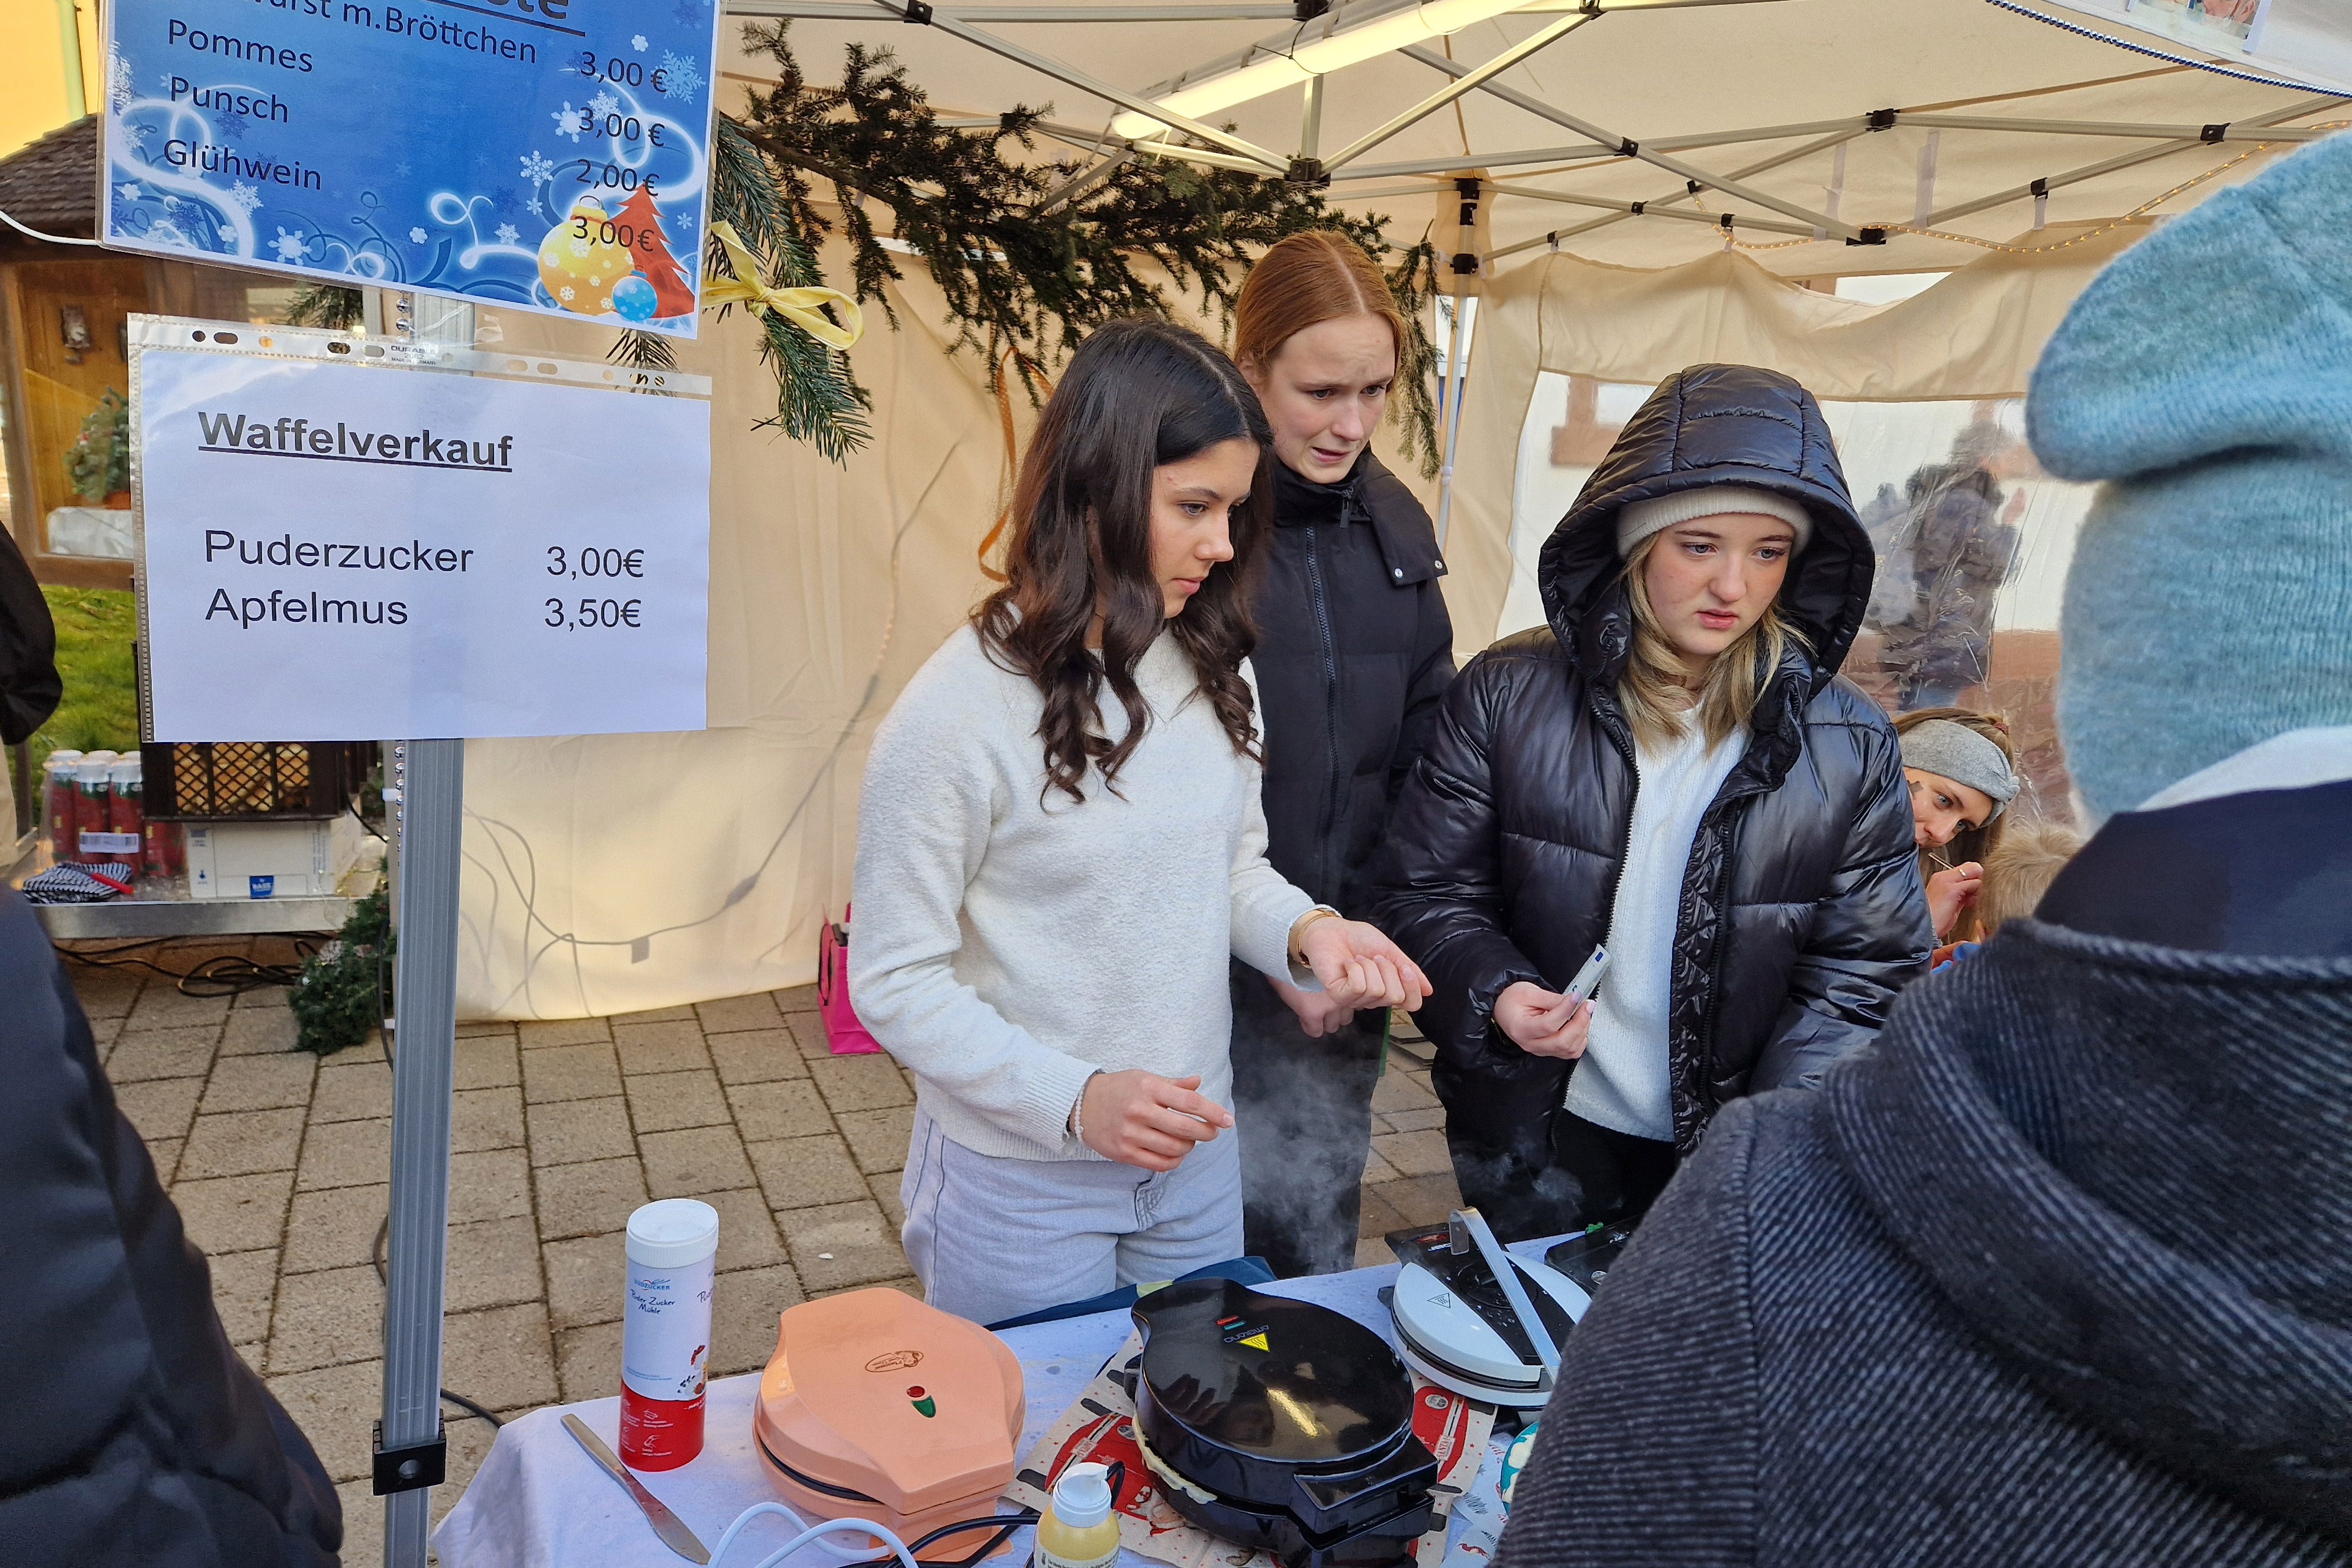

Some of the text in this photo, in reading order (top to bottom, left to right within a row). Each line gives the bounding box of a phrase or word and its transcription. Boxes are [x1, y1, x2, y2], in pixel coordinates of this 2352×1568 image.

[169, 19, 312, 72] Pommes
[171, 76, 288, 123] Punsch
[164, 139, 321, 190] Glühwein
[391, 345, 436, 354] DURABLE
[198, 411, 513, 467] Waffelverkauf
[205, 530, 644, 580] Puderzucker 3,00€
[205, 588, 642, 632] Apfelmus 3,50€
[638, 1304, 661, 1314] Mühle
[649, 1296, 676, 1306] Zucker
